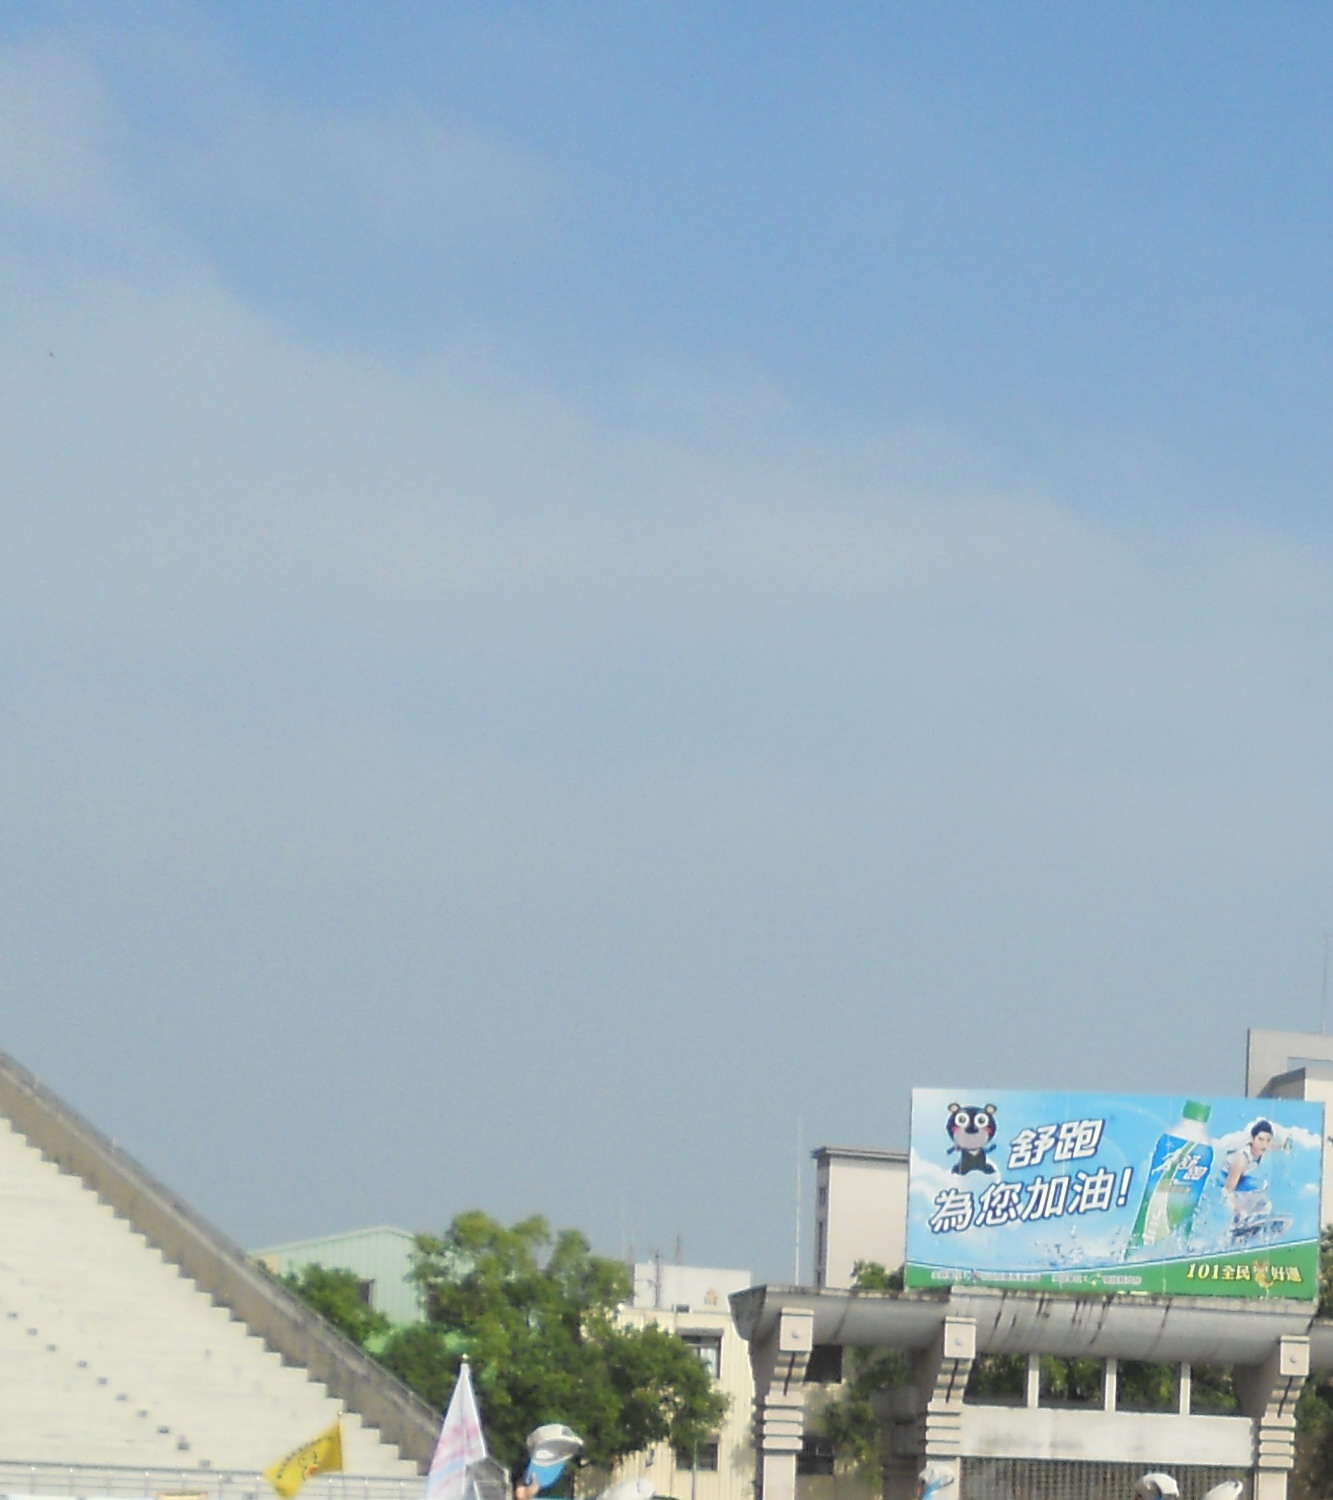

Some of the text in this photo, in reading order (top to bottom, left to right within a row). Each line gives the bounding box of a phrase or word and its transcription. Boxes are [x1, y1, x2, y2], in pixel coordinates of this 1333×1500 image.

[1008, 1117, 1105, 1170] 舒跑
[930, 1167, 1133, 1235] 為您加油!
